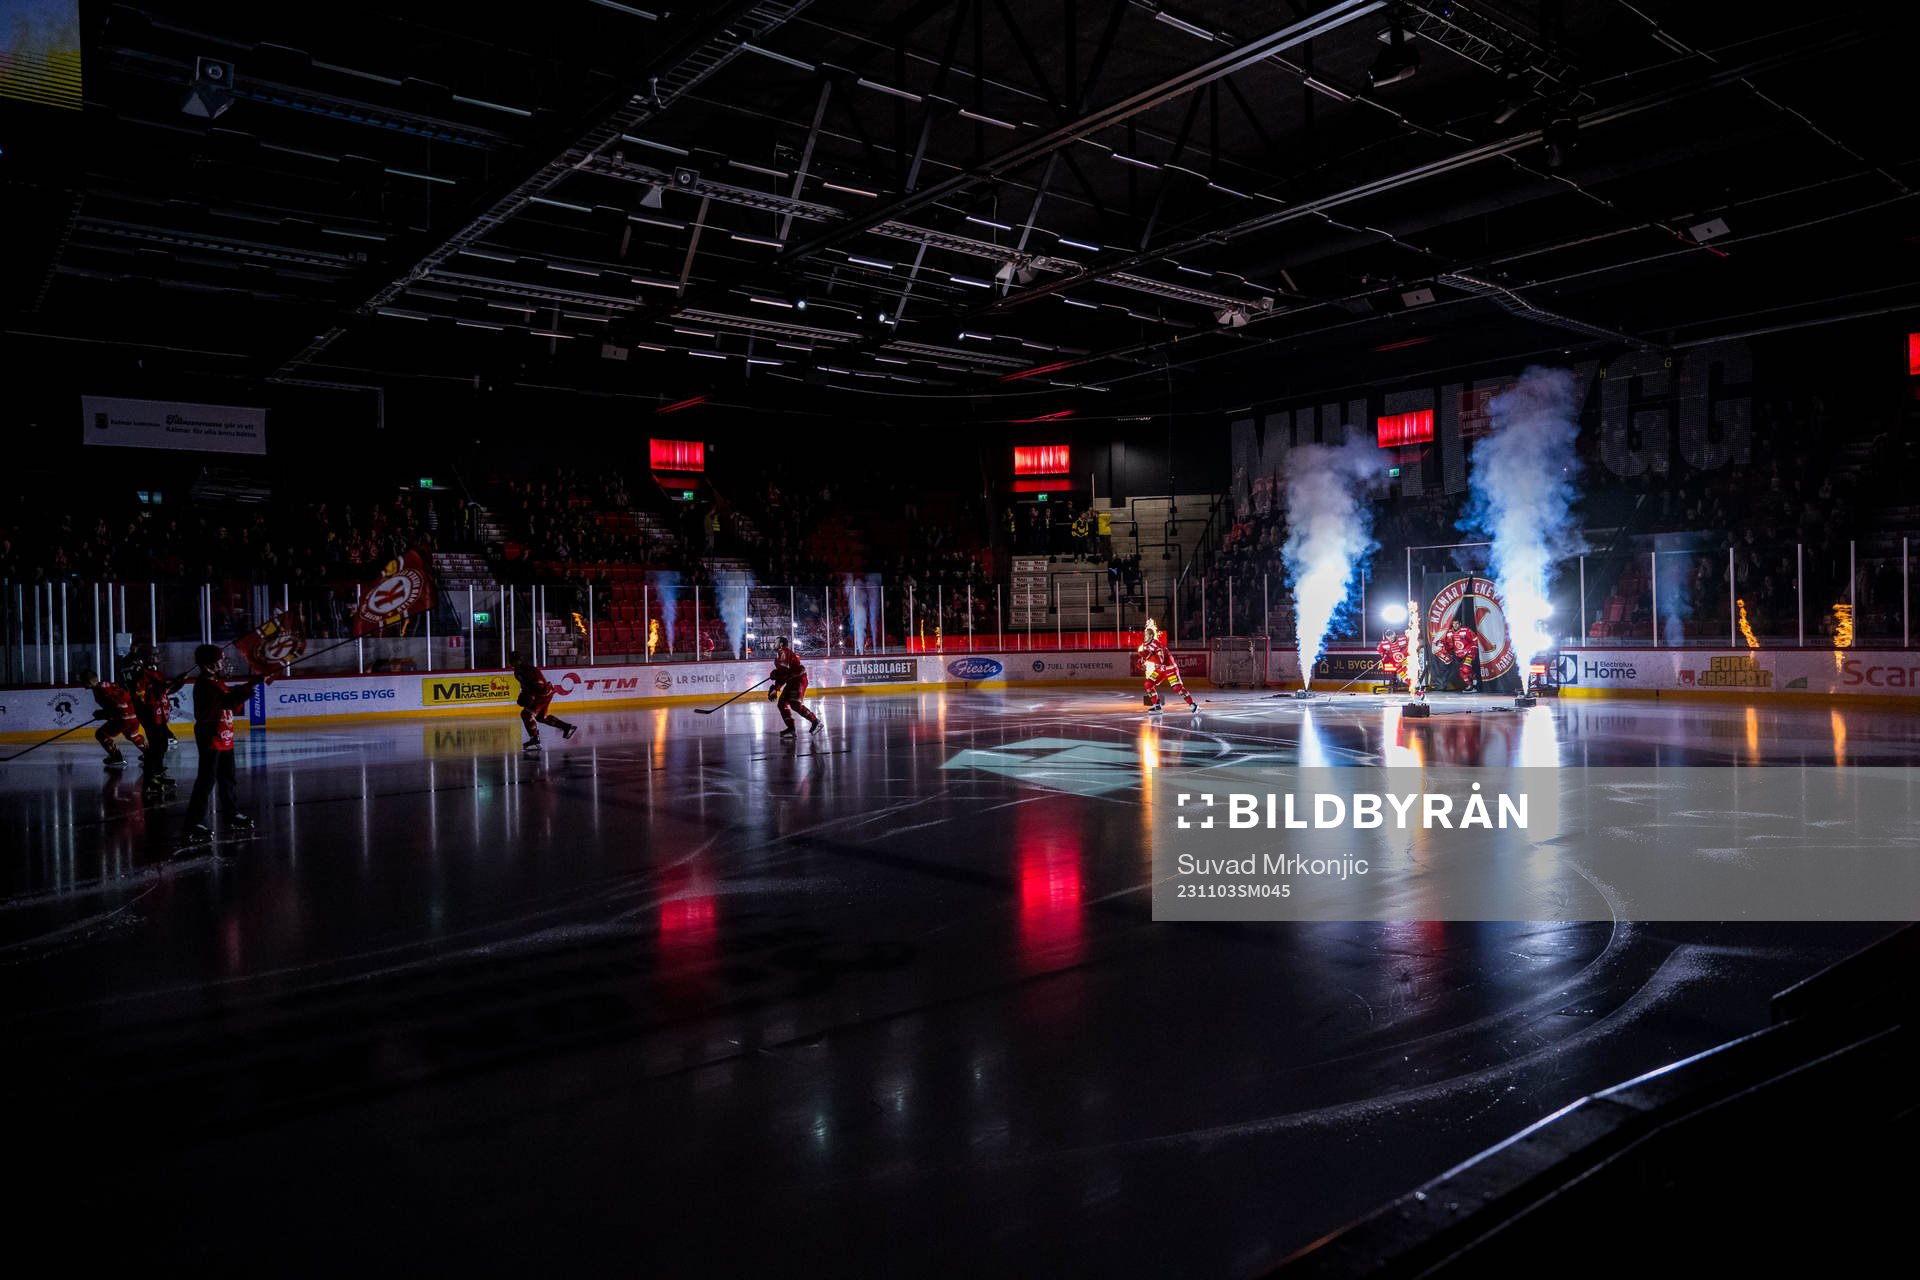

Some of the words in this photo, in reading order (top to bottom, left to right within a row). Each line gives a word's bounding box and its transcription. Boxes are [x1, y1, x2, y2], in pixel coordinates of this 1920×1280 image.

[1461, 580, 1500, 600] HCKEY
[1431, 587, 1460, 623] KALMAR
[845, 662, 912, 675] JEANSBOLAGET
[955, 660, 998, 675] Fiesta
[1066, 662, 1113, 670] ENGINEERING
[1333, 660, 1345, 670] JL
[1347, 659, 1375, 671] BYGG
[1584, 661, 1637, 679] Home
[584, 677, 638, 690] TTM
[676, 676, 689, 684] LR
[691, 674, 721, 684] SMIDE
[1697, 670, 1772, 687] JACKPOT
[279, 692, 358, 704] CARLBERGS
[362, 689, 395, 700] BYGG
[433, 682, 490, 701] MÖRE
[461, 691, 510, 699] MASKINER
